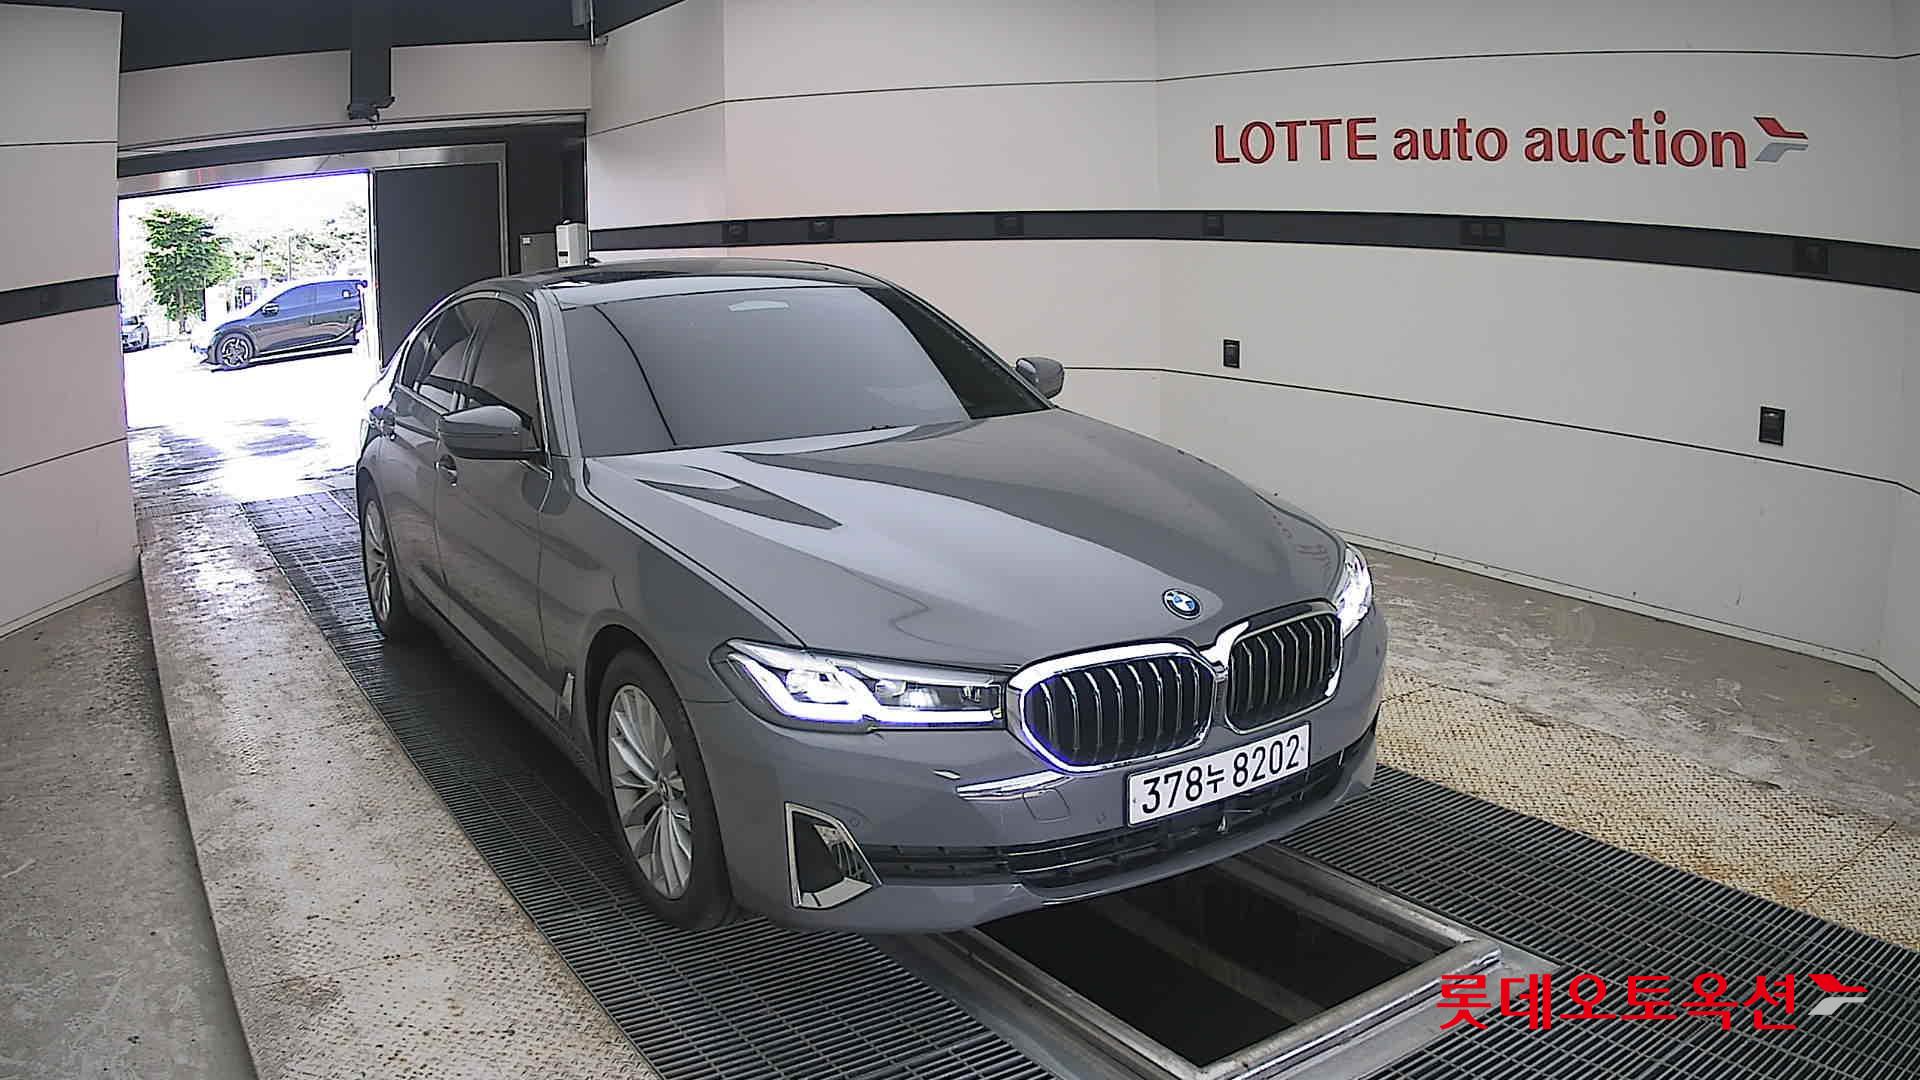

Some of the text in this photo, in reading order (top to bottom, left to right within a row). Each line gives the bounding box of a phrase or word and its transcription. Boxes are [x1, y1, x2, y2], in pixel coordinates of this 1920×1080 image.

[1215, 110, 1747, 169] LOTTE auto auction
[1142, 734, 1300, 814] 378누 8202
